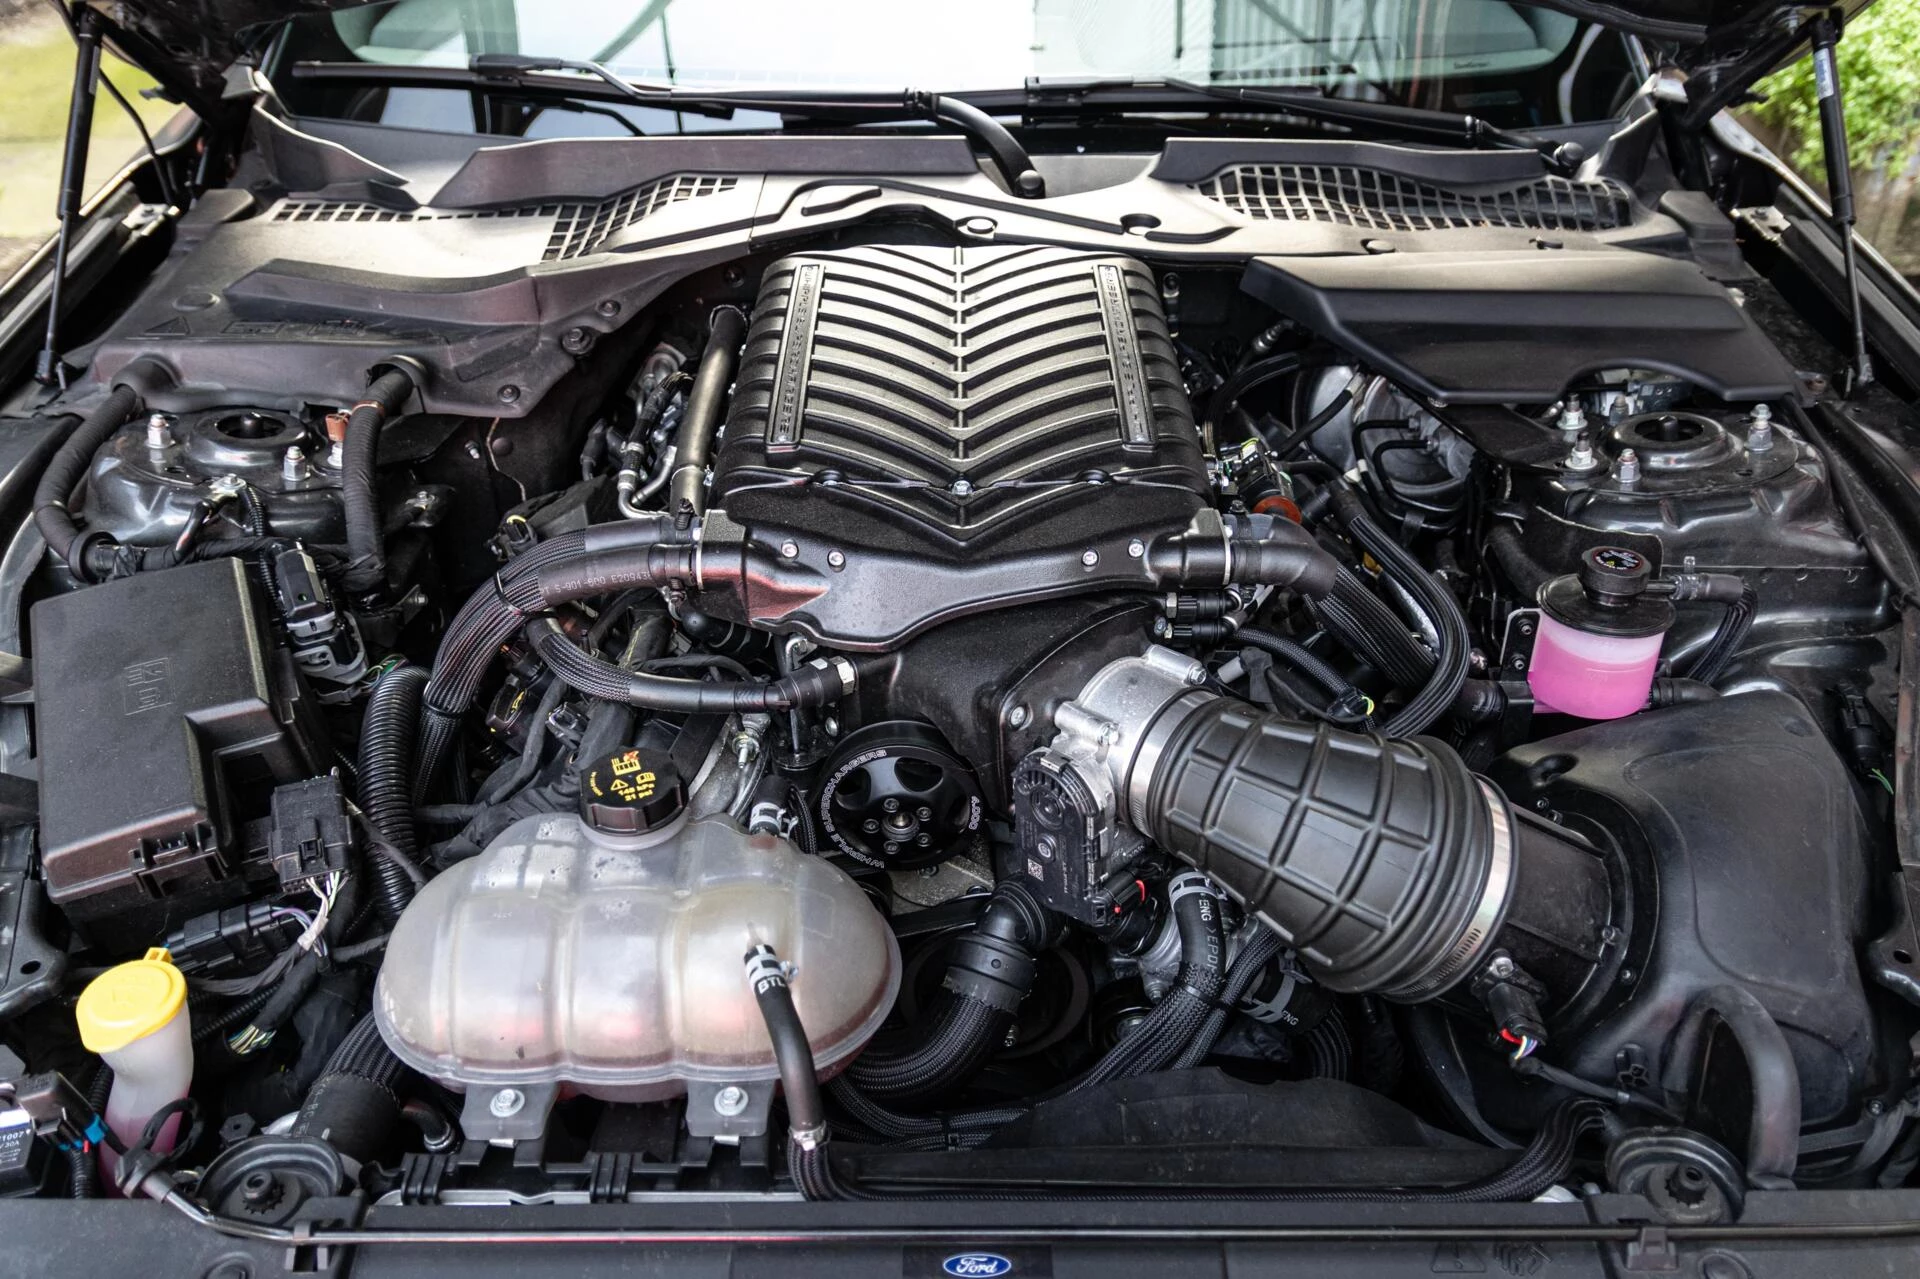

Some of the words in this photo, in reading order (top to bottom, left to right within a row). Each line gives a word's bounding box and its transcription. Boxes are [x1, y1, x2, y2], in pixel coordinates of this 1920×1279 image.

[820, 749, 887, 833] SUPERCHARGERS
[832, 834, 885, 869] WHIPPLE
[1199, 899, 1212, 921] ENG
[757, 977, 786, 994] BTL
[0, 1131, 25, 1142] 1007
